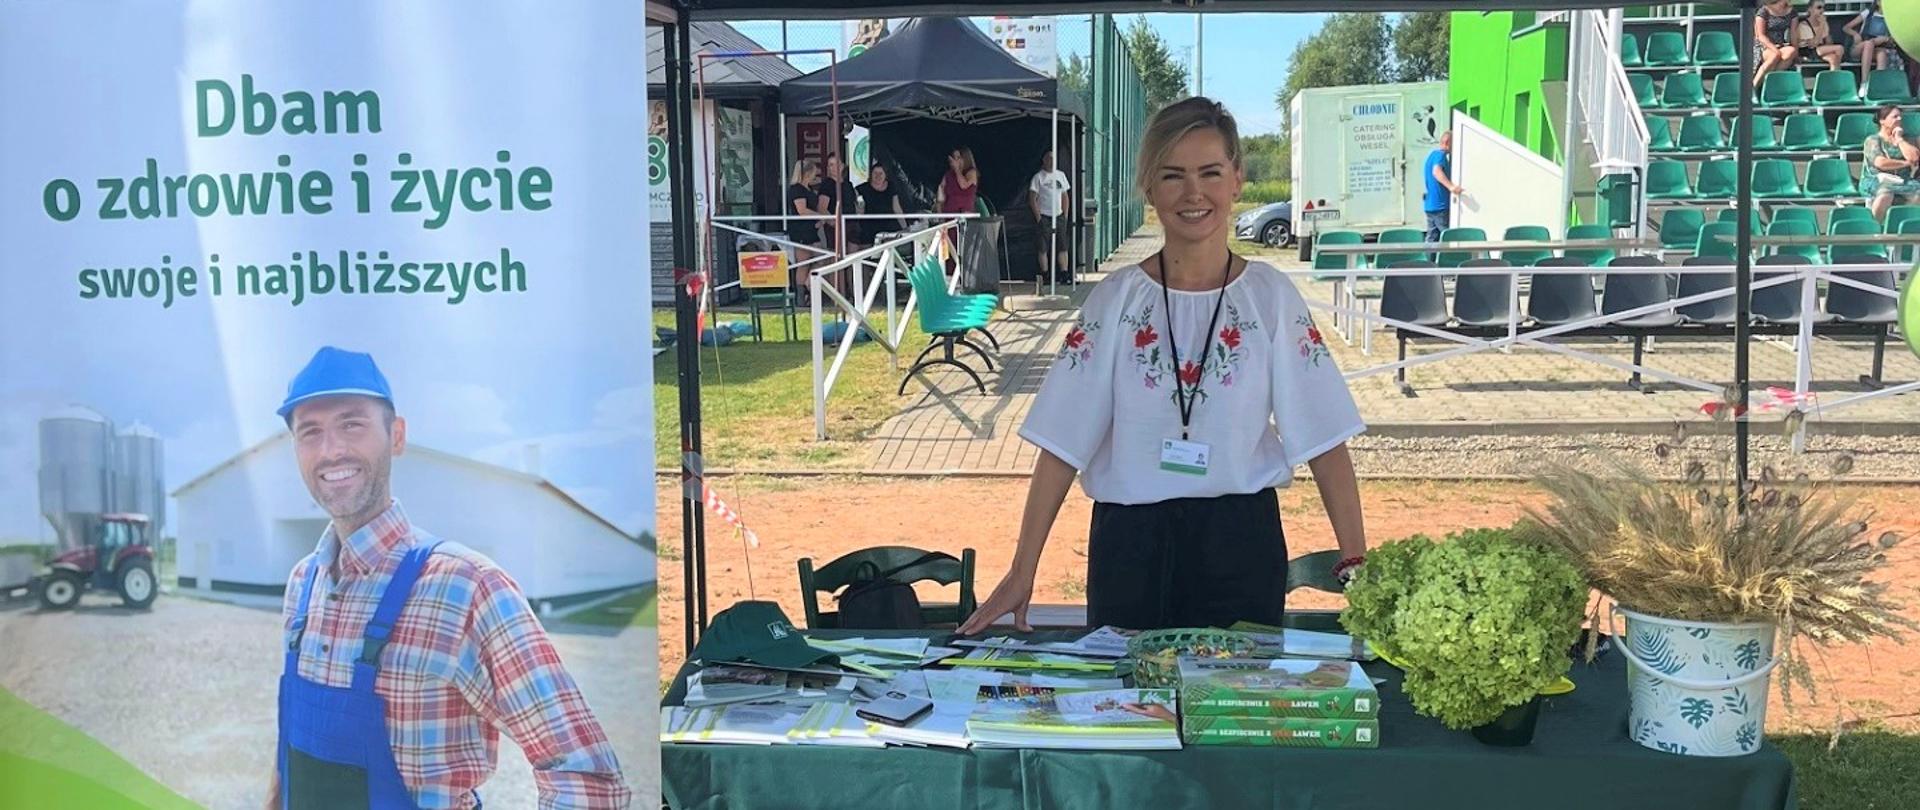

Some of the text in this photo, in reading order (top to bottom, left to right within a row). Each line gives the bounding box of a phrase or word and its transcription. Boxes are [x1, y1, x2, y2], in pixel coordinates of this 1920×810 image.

[196, 74, 381, 137] Dbam
[1352, 123, 1396, 133] CATERING
[1359, 142, 1391, 151] WESEL
[43, 151, 553, 229] o zdrowie i życie
[79, 248, 526, 308] swoje i najbliższych
